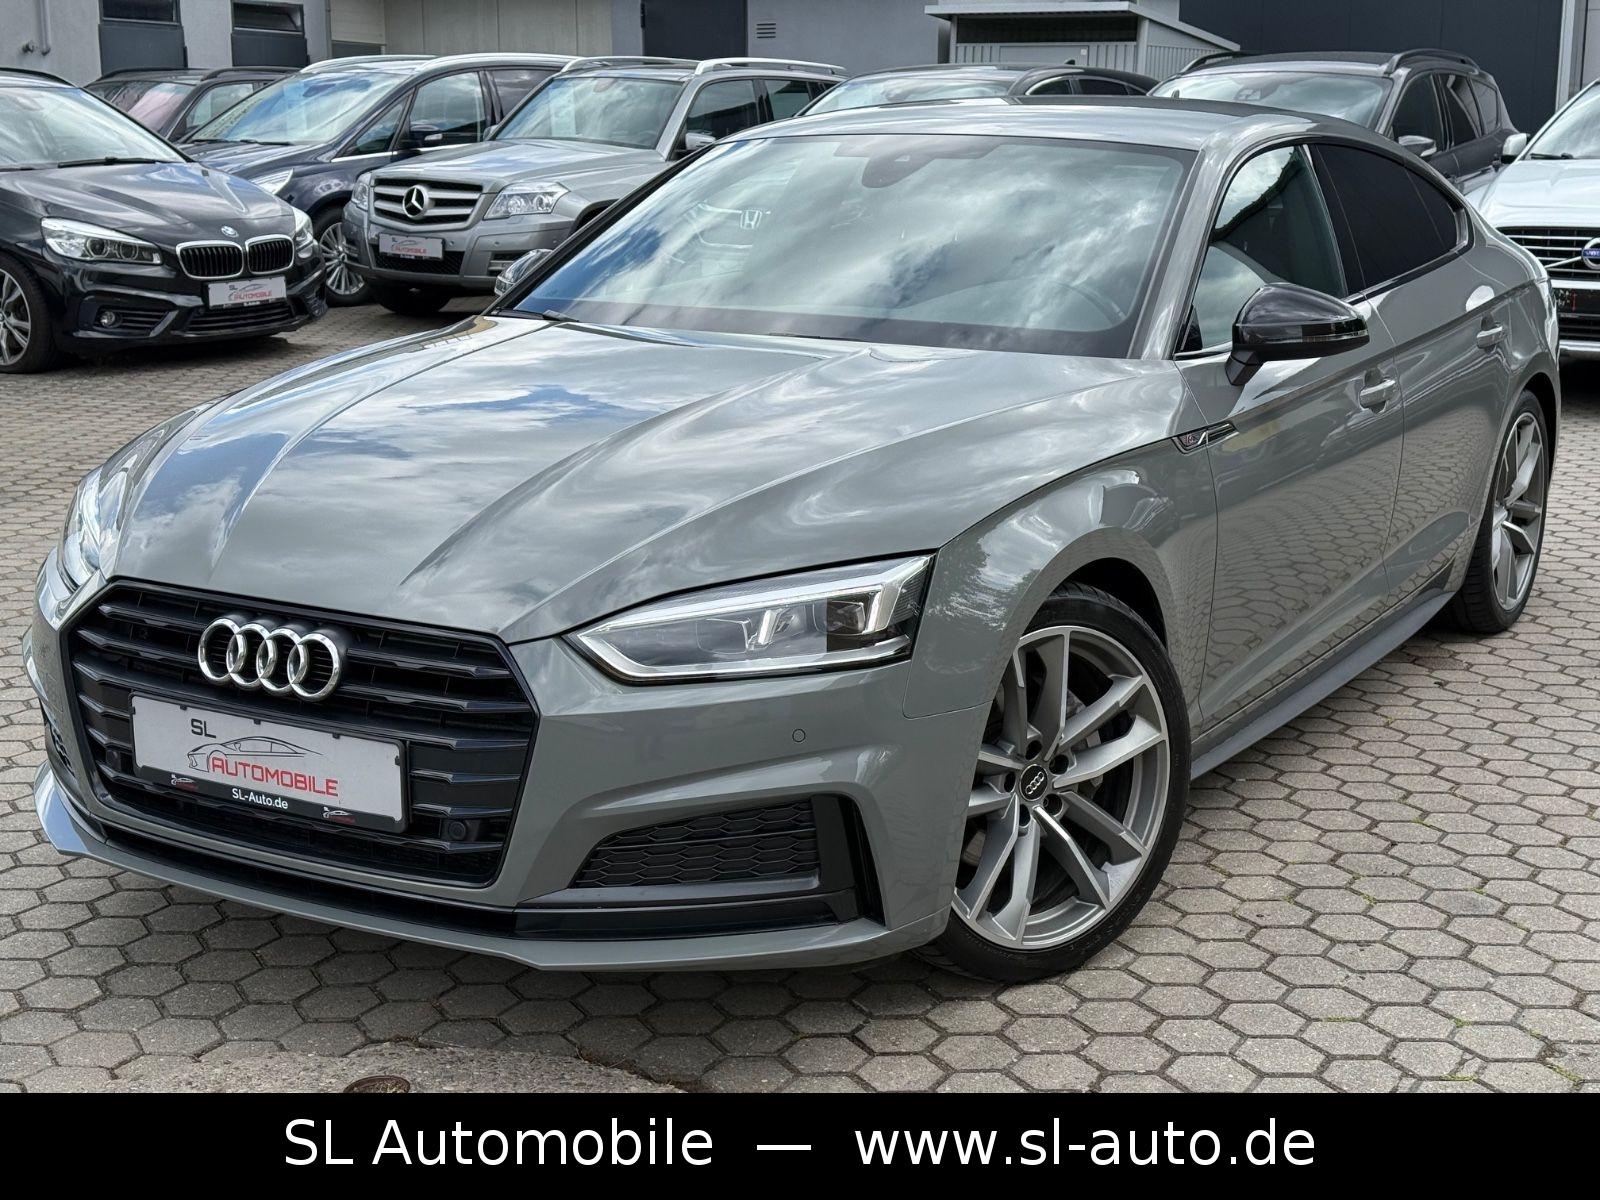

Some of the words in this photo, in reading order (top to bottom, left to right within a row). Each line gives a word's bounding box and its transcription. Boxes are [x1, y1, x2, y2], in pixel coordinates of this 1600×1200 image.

[190, 718, 217, 739] SL
[211, 756, 339, 797] AUTOMOBILE
[231, 788, 289, 810] SL-Auto.de
